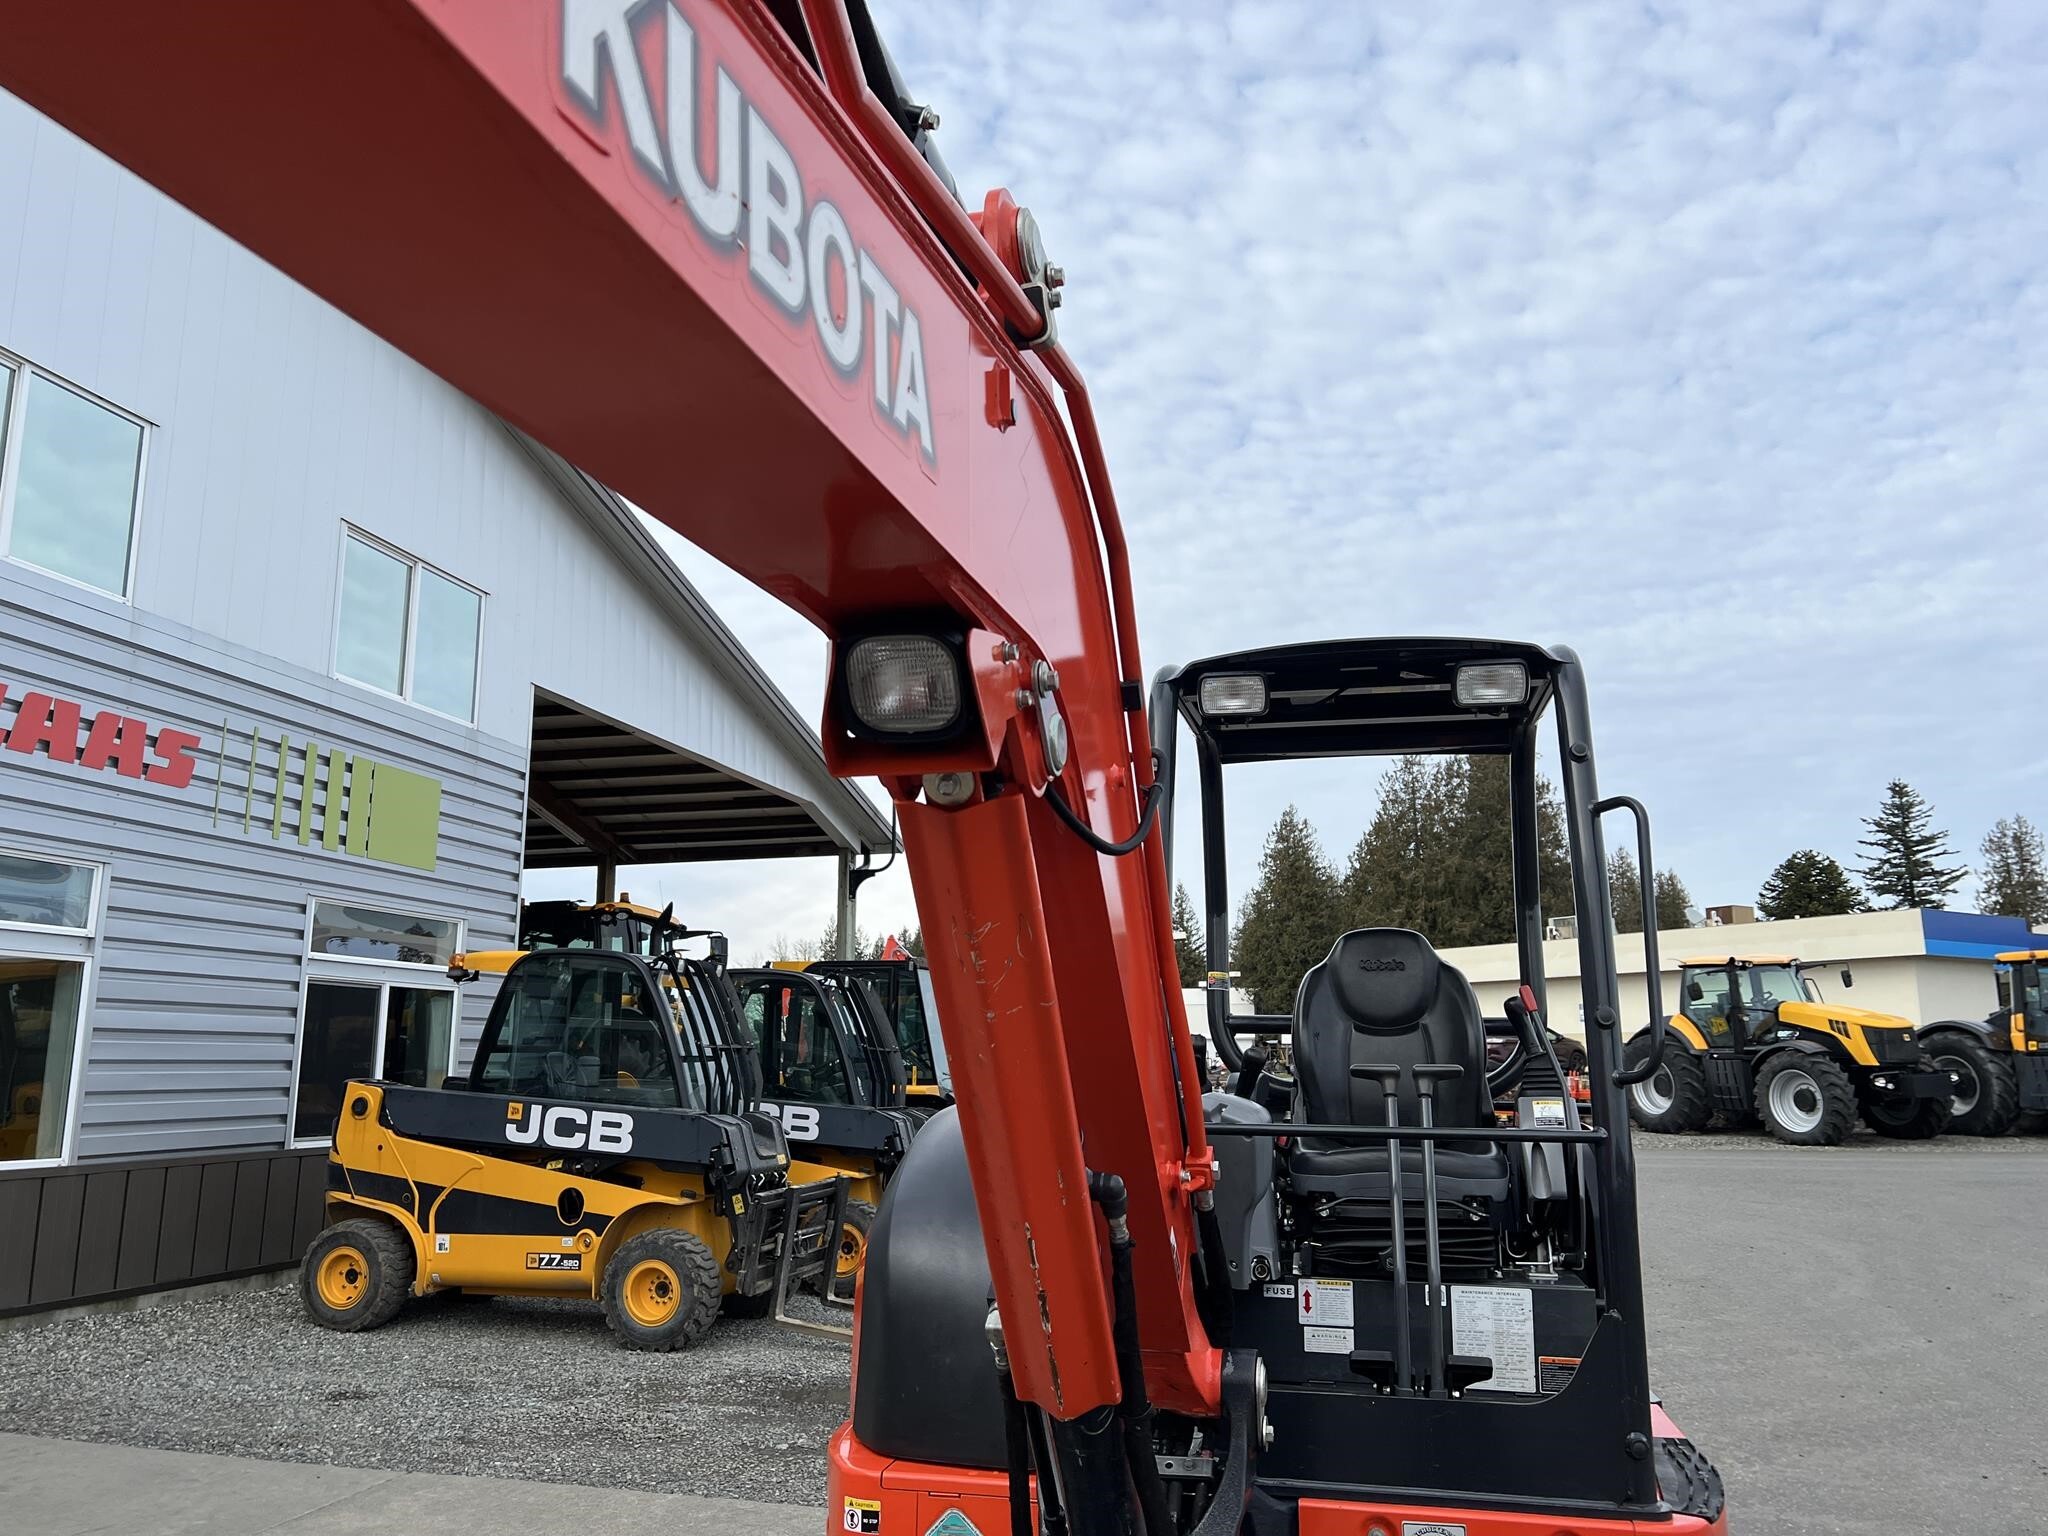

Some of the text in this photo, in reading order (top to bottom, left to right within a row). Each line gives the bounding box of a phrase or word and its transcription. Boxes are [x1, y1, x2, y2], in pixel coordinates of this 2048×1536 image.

[563, 0, 934, 458] KUBOTA
[0, 683, 201, 788] AAS
[505, 1104, 634, 1154] JCB
[1266, 1287, 1293, 1296] FUSE
